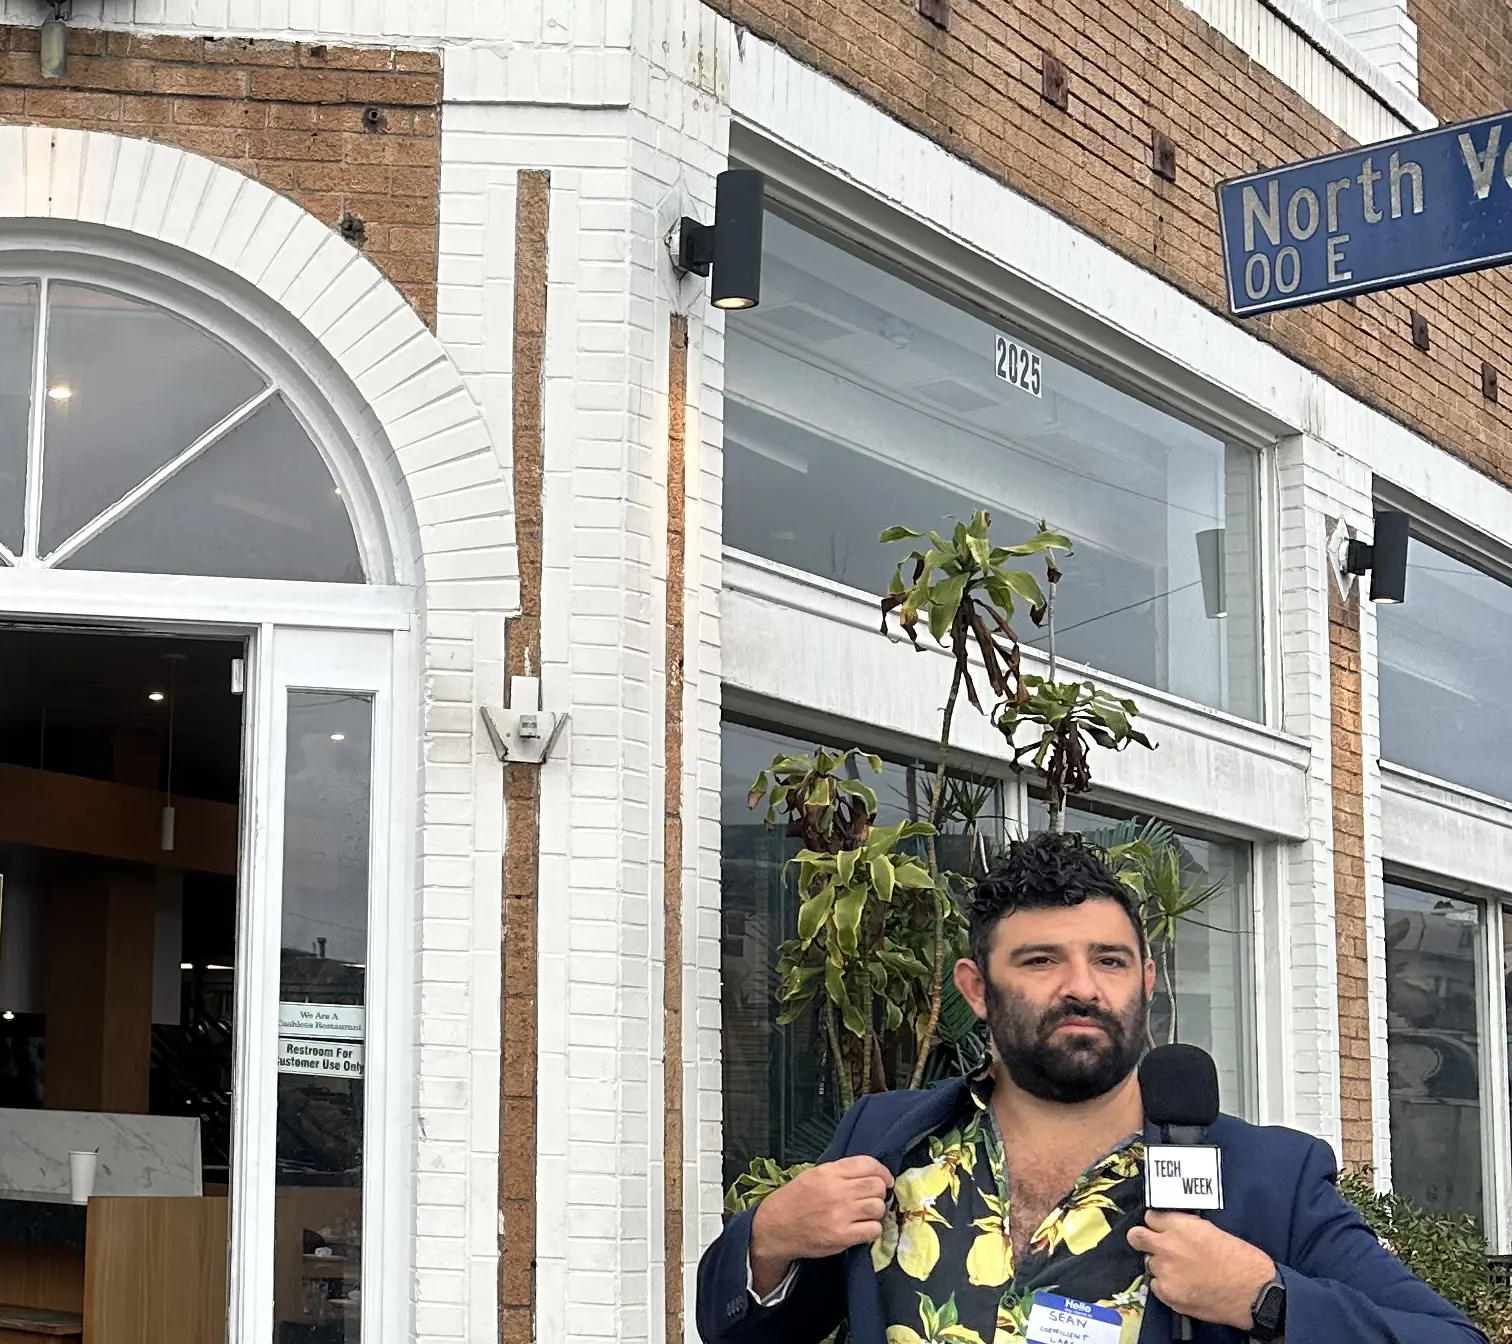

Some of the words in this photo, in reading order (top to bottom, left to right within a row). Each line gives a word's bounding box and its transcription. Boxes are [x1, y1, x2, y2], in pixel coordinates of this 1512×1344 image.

[1242, 150, 1424, 253] North
[1244, 246, 1300, 300] 00
[1326, 235, 1352, 283] E
[997, 337, 1040, 395] 2025
[315, 1012, 330, 1020] Are
[315, 1022, 362, 1031] Restaurant
[287, 1043, 333, 1057] Restroom
[336, 1048, 353, 1058] For
[322, 1059, 340, 1070] Use
[343, 1061, 364, 1074] Only
[1154, 1160, 1181, 1177] TECH
[1182, 1177, 1213, 1195] WEEK
[1065, 1298, 1091, 1313] Hello
[1049, 1311, 1087, 1328] SEAN
